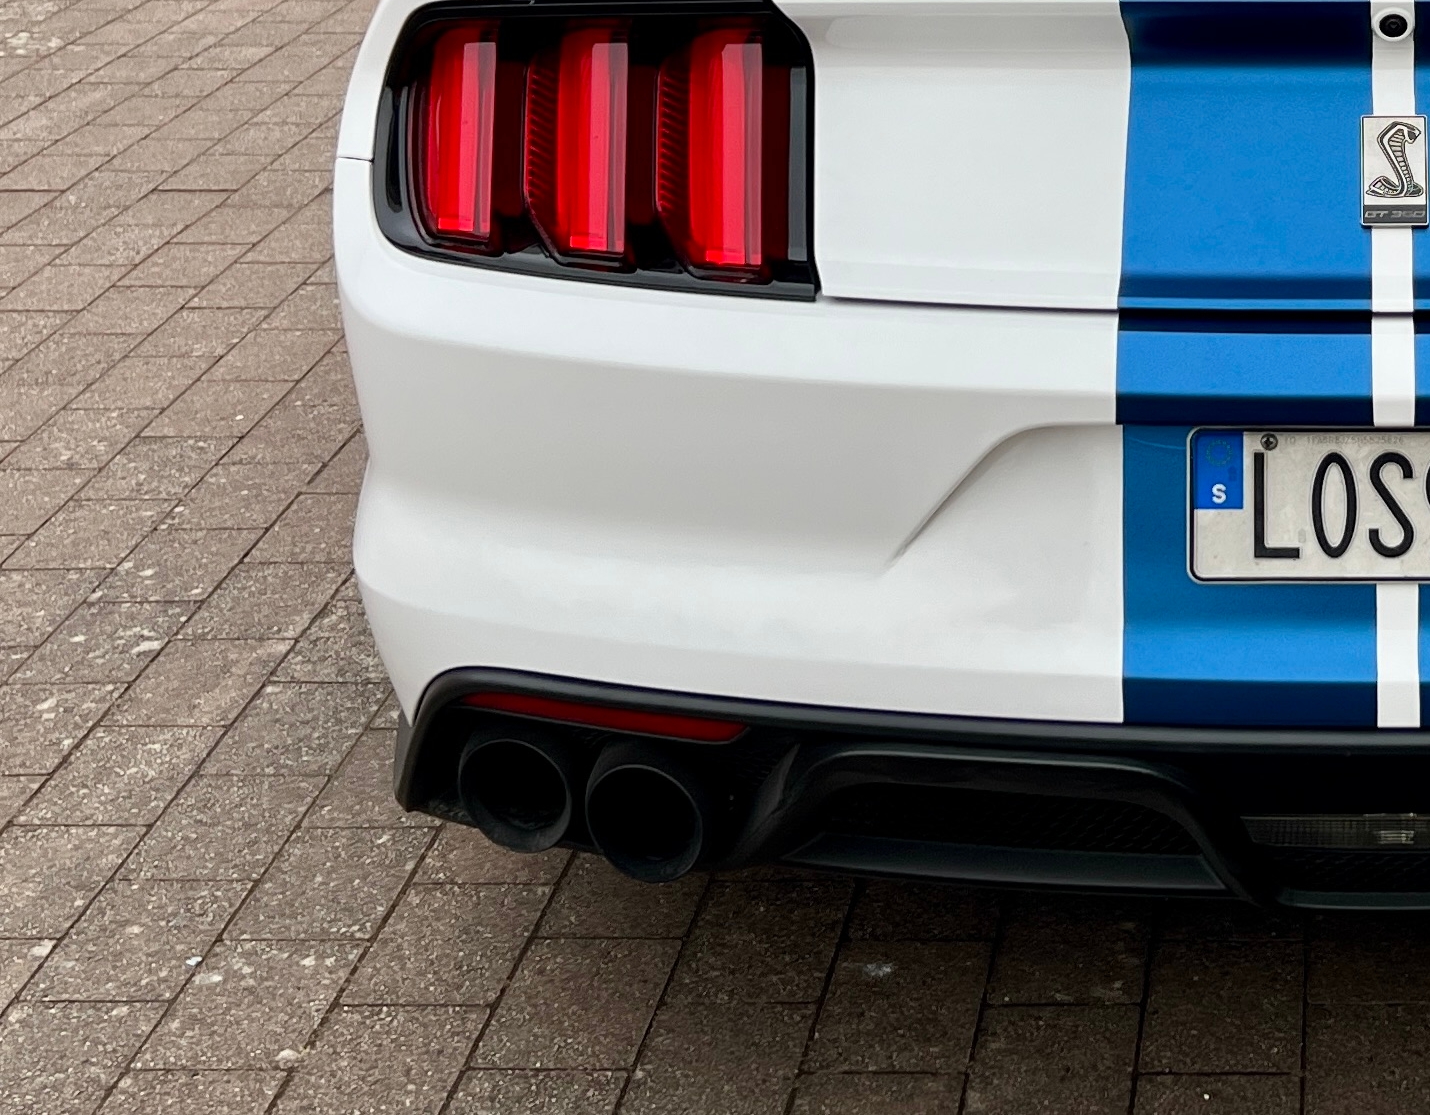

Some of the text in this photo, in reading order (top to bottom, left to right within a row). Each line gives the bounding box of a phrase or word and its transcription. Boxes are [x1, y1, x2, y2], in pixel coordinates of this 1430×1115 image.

[1364, 210, 1426, 218] GT 350
[1211, 483, 1227, 504] S
